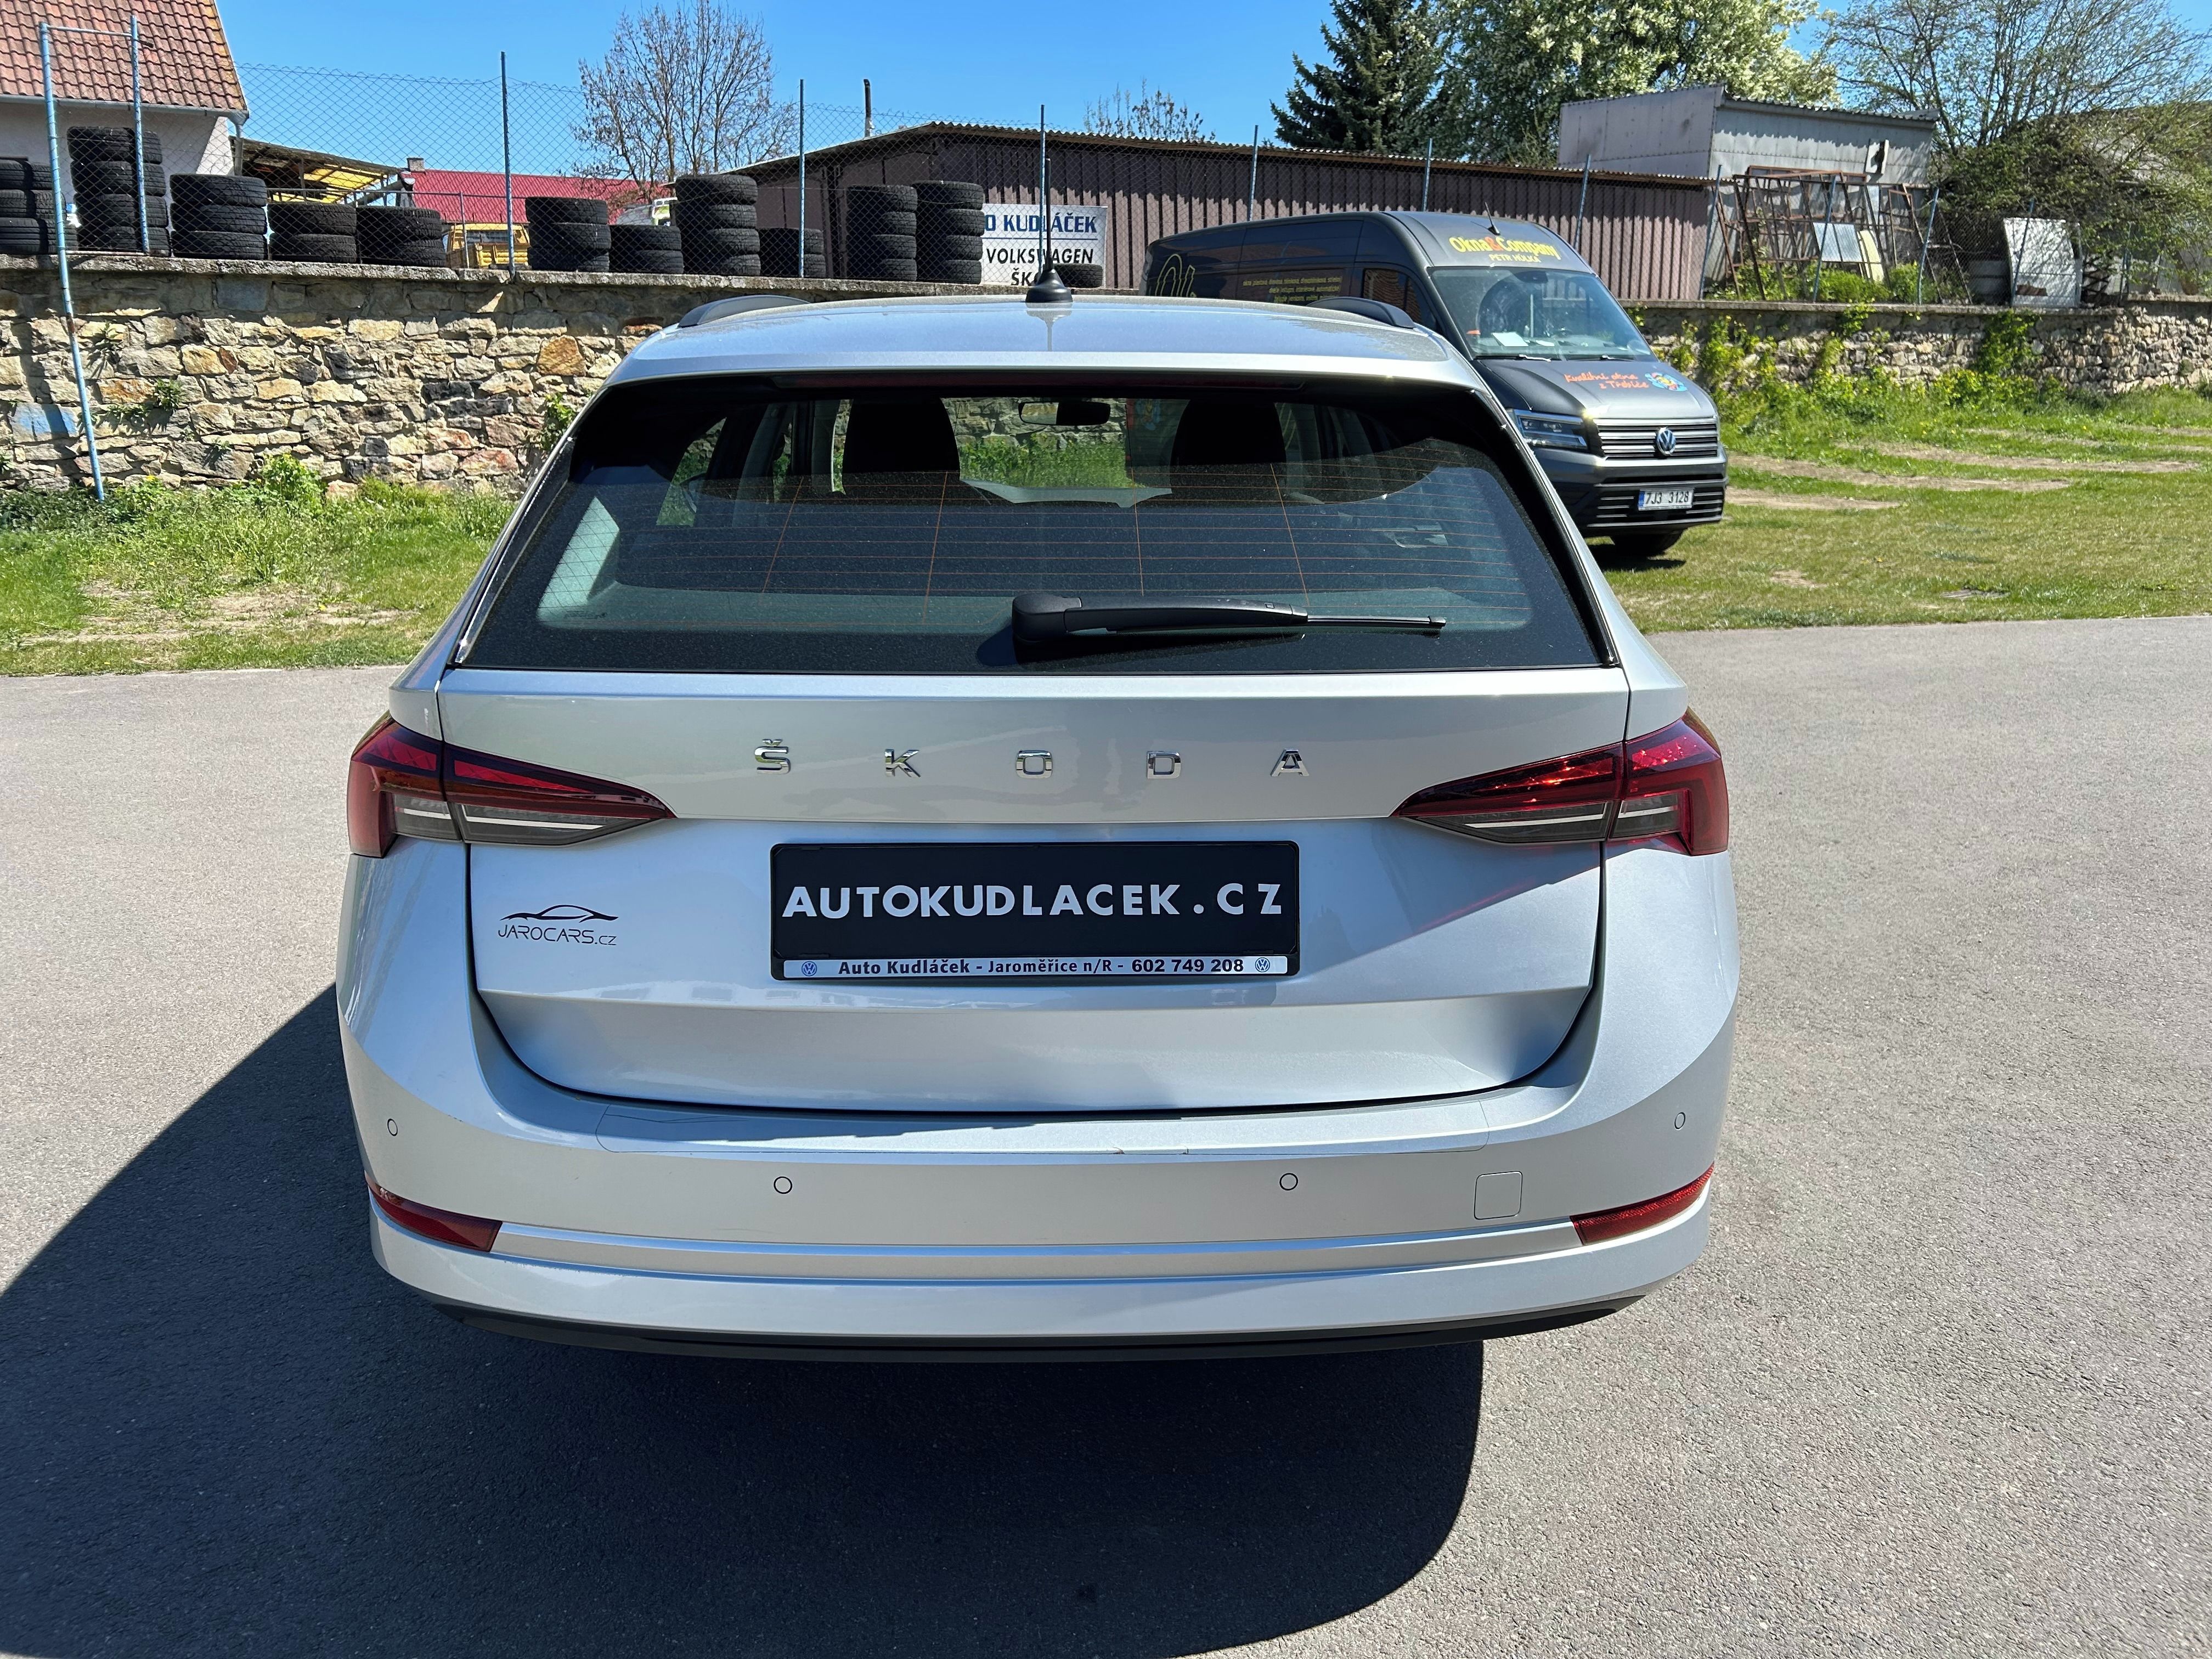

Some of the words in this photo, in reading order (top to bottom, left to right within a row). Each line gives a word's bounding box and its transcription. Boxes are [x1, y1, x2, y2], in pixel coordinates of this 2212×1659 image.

[1003, 212, 1097, 233] KUDLÁČEK
[1449, 236, 1561, 260] Okna&Company
[1646, 492, 1662, 504] 7J3
[1668, 490, 1689, 503] 3128
[838, 961, 881, 975] Auto
[887, 960, 970, 974] Kudláček
[988, 958, 1077, 973] Jaroměřice
[1084, 958, 1113, 974] n/R
[1131, 959, 1165, 973] 602
[1171, 959, 1205, 972] 749
[1210, 958, 1244, 972] 208
